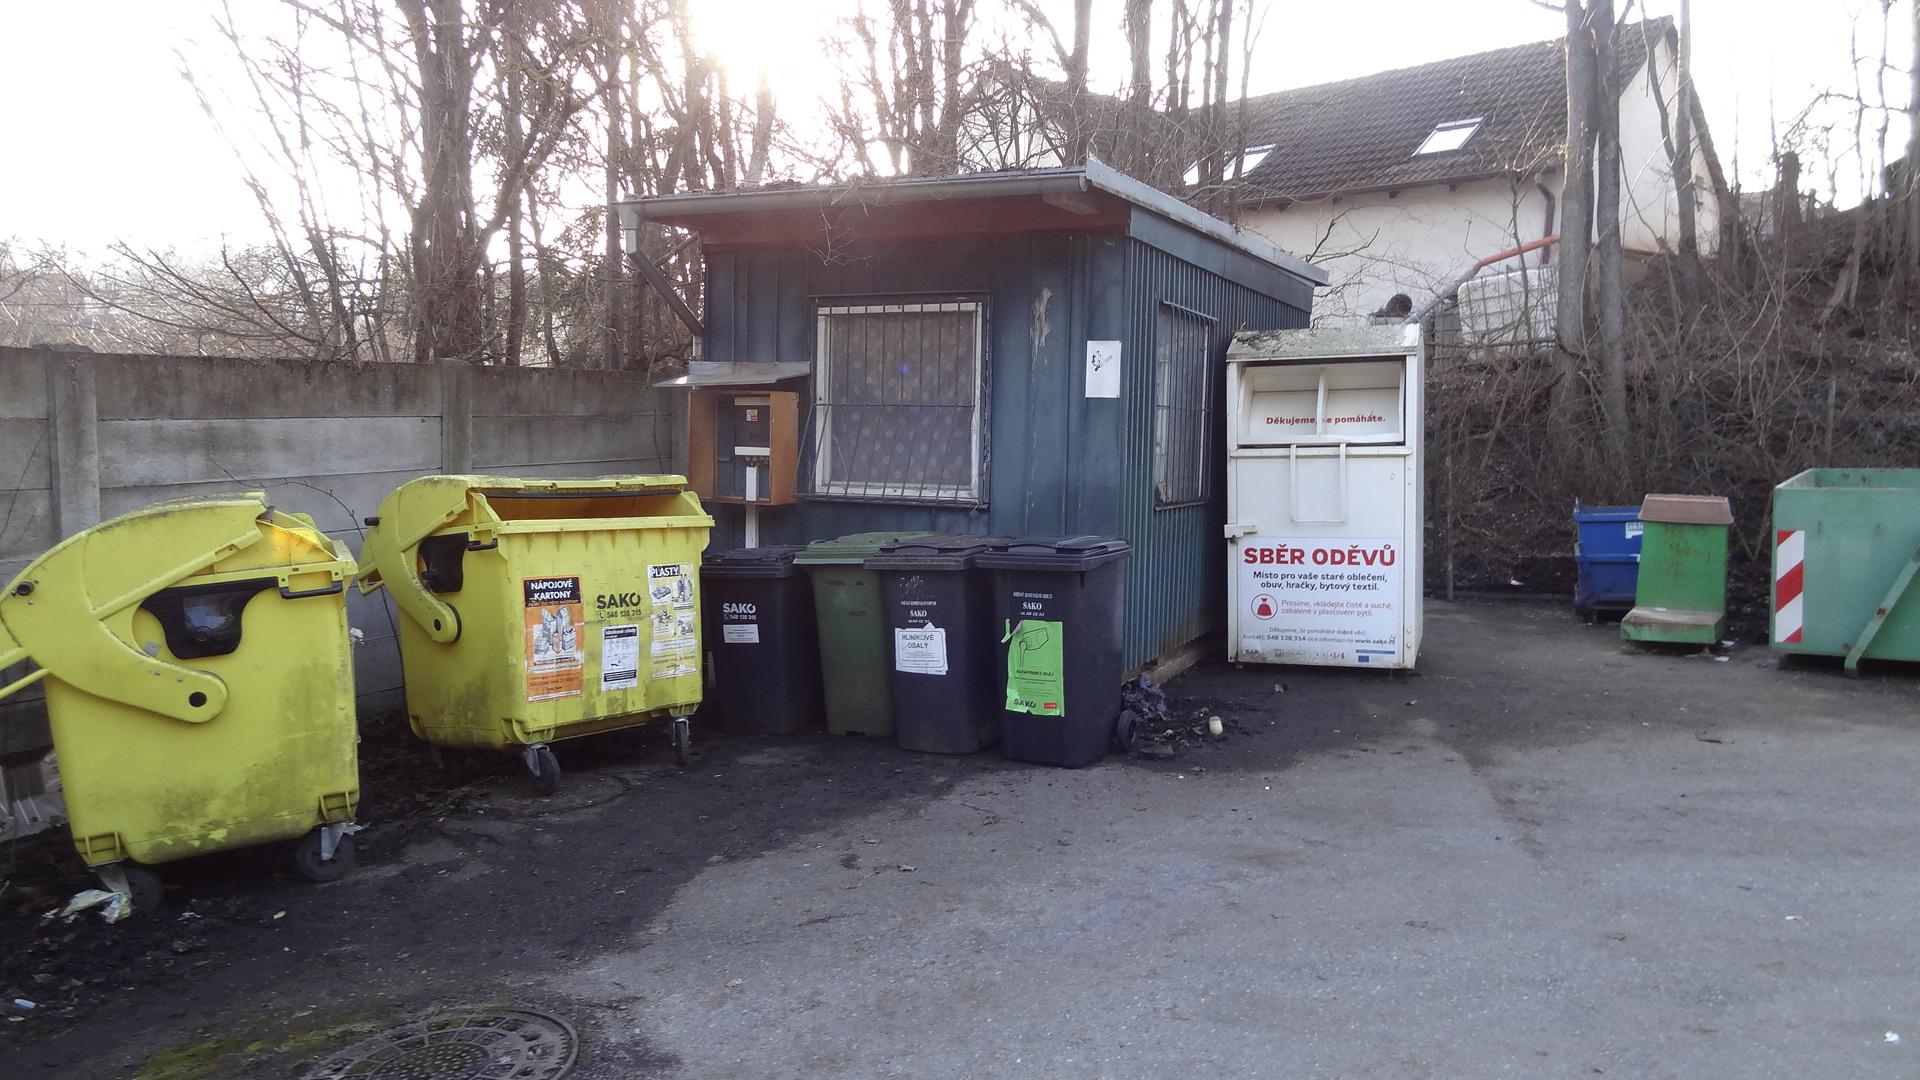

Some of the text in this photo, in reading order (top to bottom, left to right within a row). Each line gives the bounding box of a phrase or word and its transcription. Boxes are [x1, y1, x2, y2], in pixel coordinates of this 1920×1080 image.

[1266, 416, 1317, 425] Děkujeme,
[1334, 413, 1386, 425] pomáháte.
[1244, 544, 1395, 566] SBĚR ODĚVŮ
[650, 566, 679, 577] PLASTY
[1254, 571, 1388, 583] Místo pro vaše staré oblečení,
[531, 579, 573, 590] NÁPOJOVÉ
[1260, 581, 1380, 592] obuv, hračky, bytový textil.
[534, 591, 571, 600] KARTONY
[597, 592, 641, 609] SAKO
[723, 602, 757, 614] SAKO
[1022, 601, 1043, 610] SAKO
[1281, 599, 1311, 607] Prosíme,
[1014, 698, 1036, 708] SAKO
